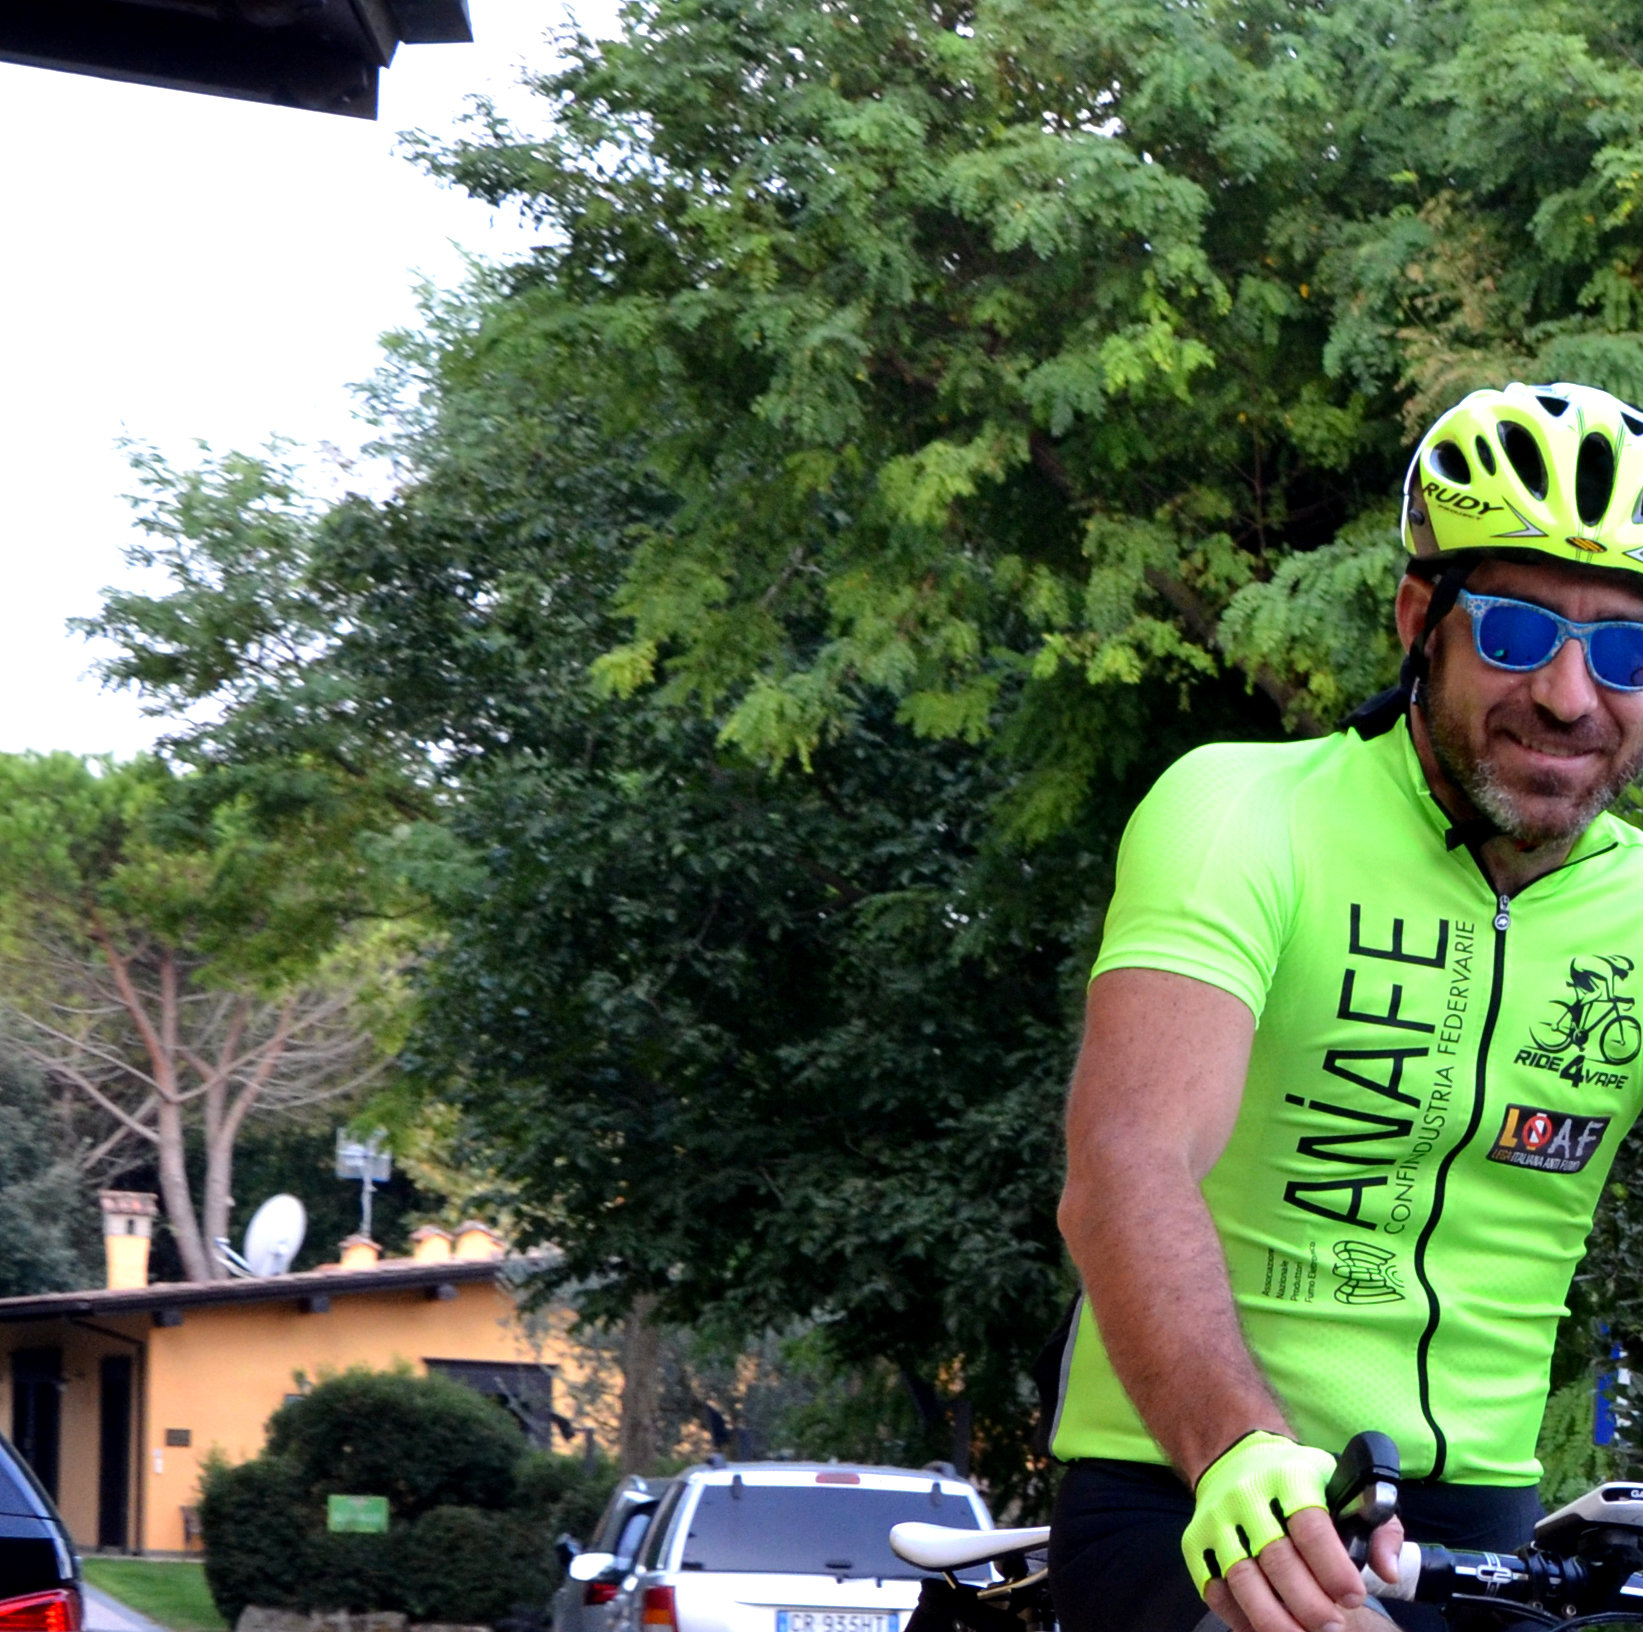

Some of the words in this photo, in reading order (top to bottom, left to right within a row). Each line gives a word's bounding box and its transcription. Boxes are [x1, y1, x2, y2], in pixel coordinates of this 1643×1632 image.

[1422, 482, 1504, 515] RUDY
[1384, 1066, 1454, 1235] CONFINDUSTRIA
[1437, 920, 1475, 1057] FEDERVARIE
